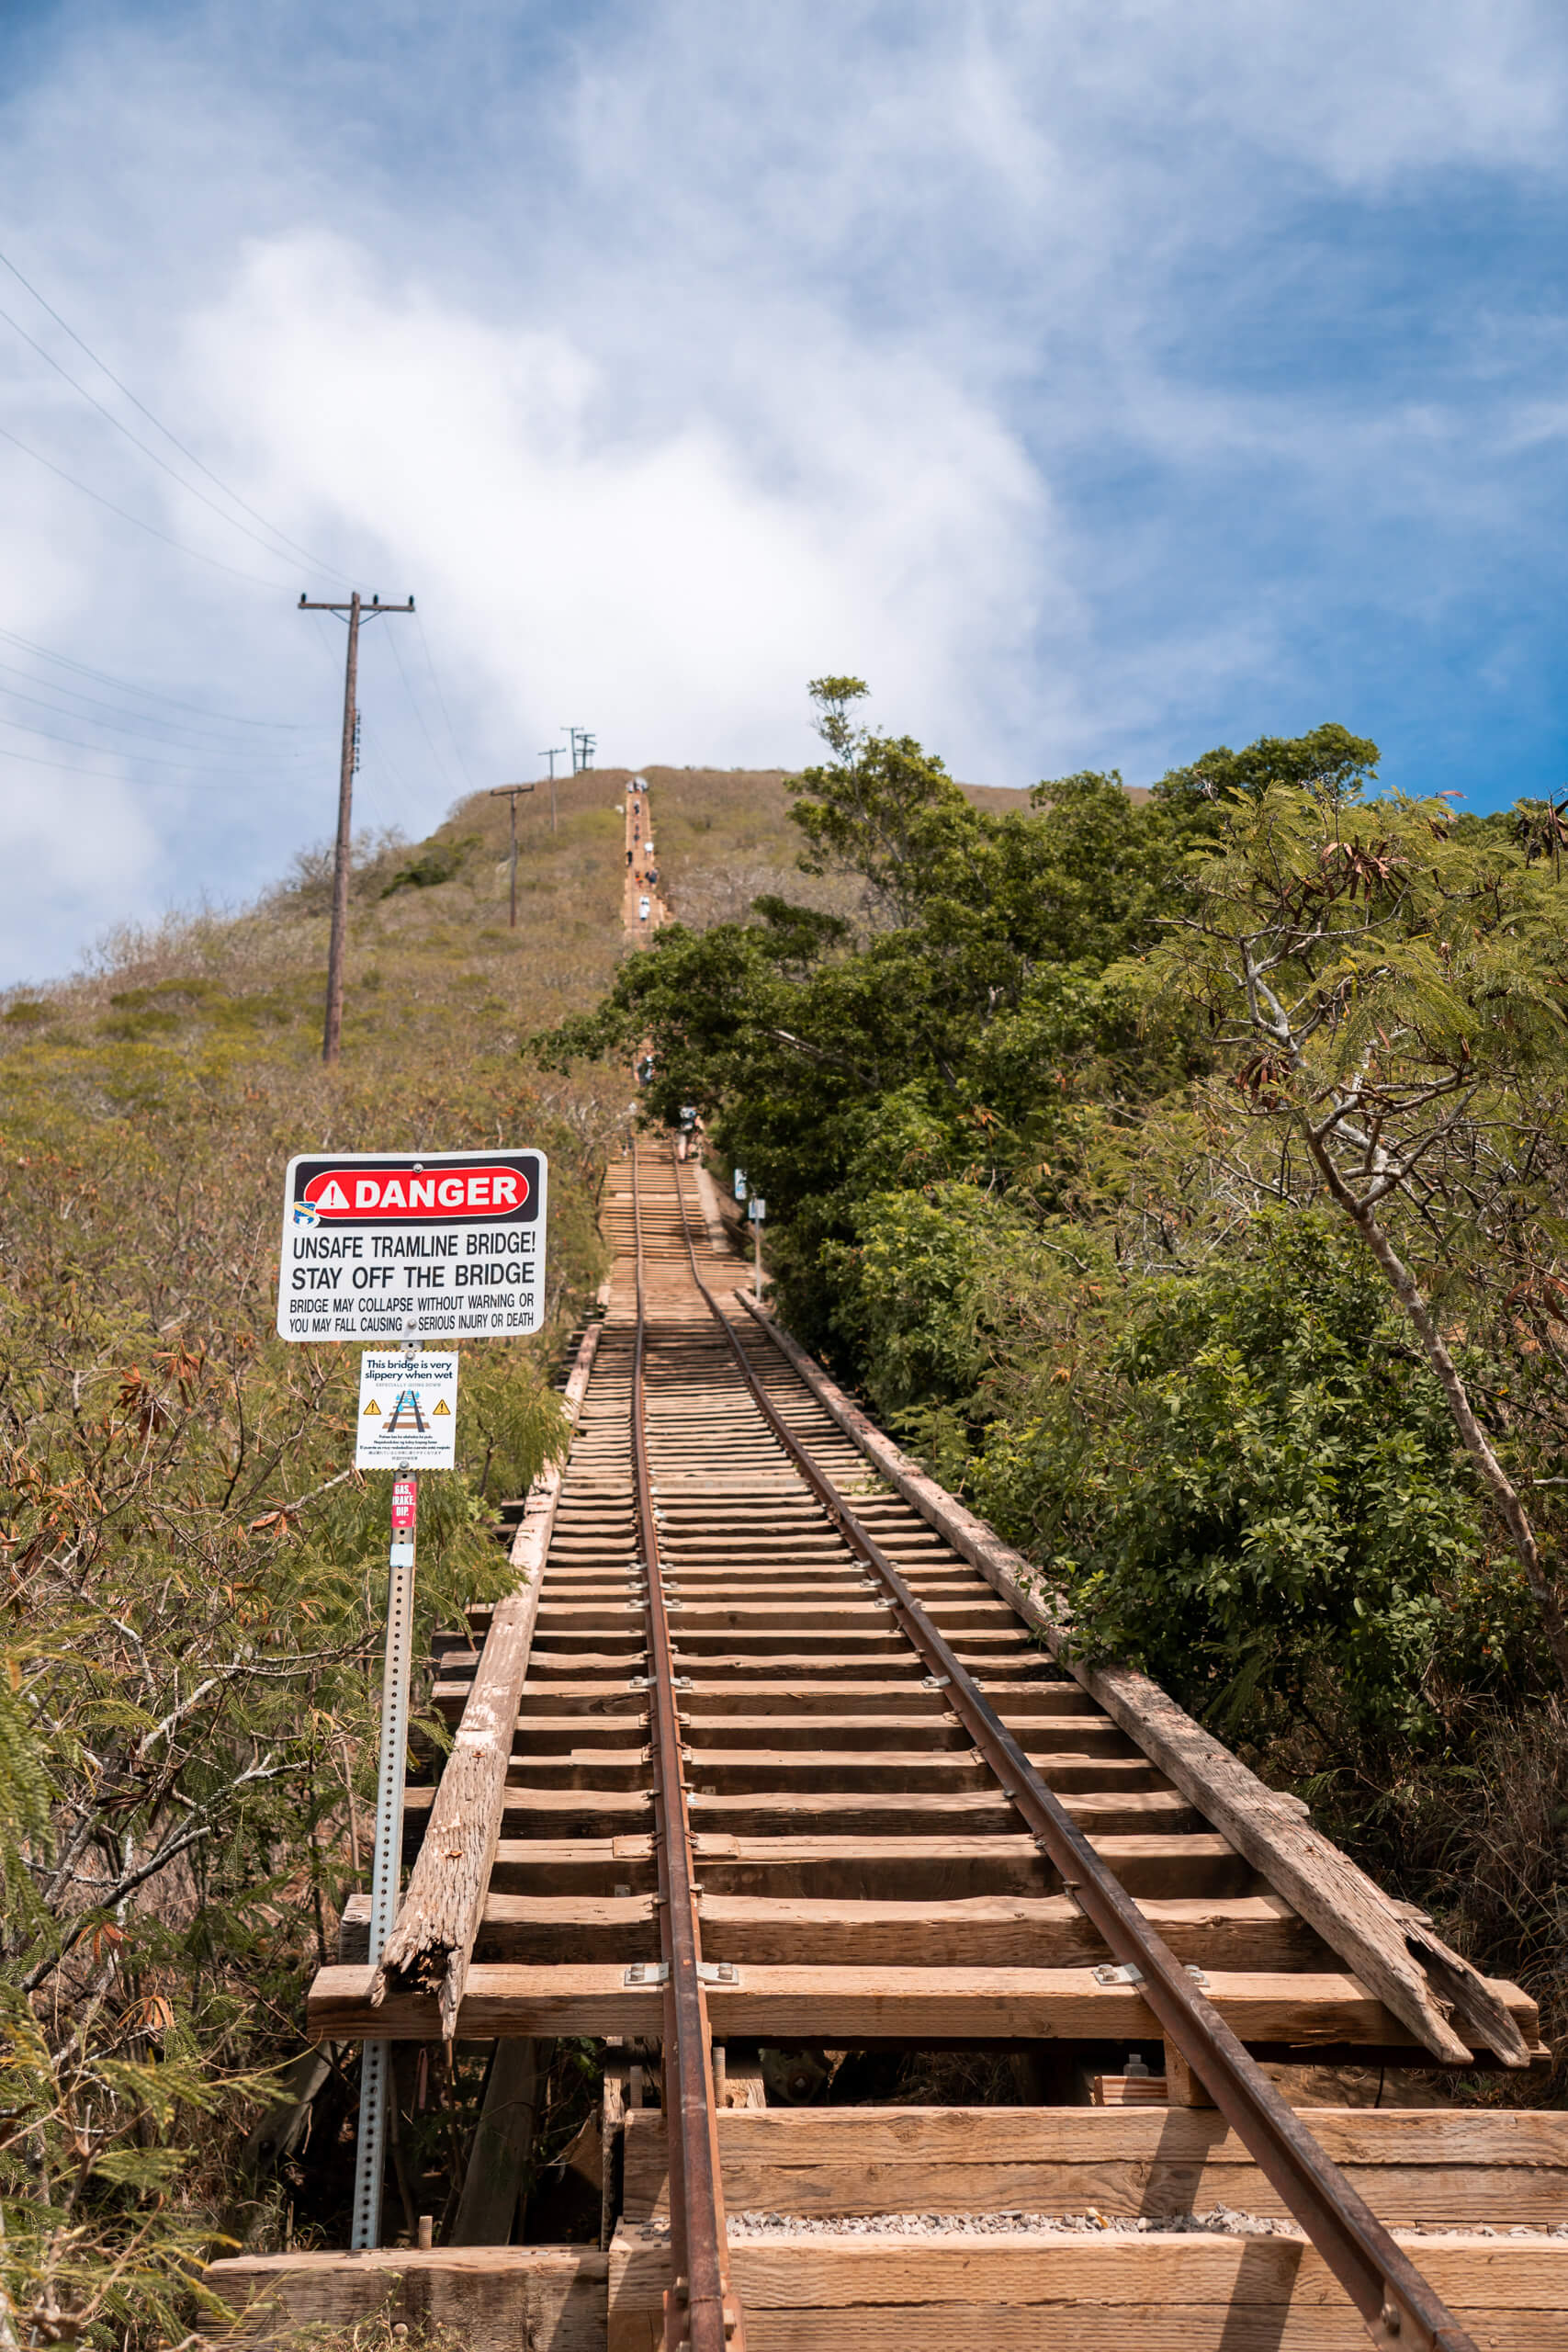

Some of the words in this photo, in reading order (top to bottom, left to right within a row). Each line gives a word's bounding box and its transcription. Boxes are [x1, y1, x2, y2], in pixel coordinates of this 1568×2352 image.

[355, 1177, 517, 1208] DANGER
[293, 1237, 364, 1260] UNSAFE
[371, 1235, 458, 1258] TRAMLINE
[466, 1231, 536, 1255] BRIDGE!
[291, 1267, 343, 1290] STAY
[352, 1267, 395, 1289] OFF
[403, 1266, 445, 1288] THE
[455, 1261, 535, 1286] BRIDGE
[289, 1299, 329, 1313] BRIDGE
[333, 1298, 355, 1312] MAY
[358, 1297, 413, 1312] COLLAPSE
[417, 1295, 464, 1311] WITHOUT
[468, 1294, 514, 1309] WARNING
[519, 1293, 534, 1307] OR
[289, 1318, 309, 1332] YOU
[312, 1317, 332, 1332] MAY
[334, 1317, 356, 1331] FALL
[360, 1317, 402, 1331] CAUSING
[418, 1315, 456, 1330] SERIOUS
[458, 1314, 488, 1329] INJURY
[491, 1314, 503, 1328] OR
[506, 1312, 534, 1327] DEATH
[365, 1370, 403, 1381] slippery
[405, 1370, 432, 1379] when
[434, 1371, 453, 1379] wet
[367, 1360, 386, 1369] This
[388, 1360, 419, 1371] bridge
[421, 1360, 428, 1369] is
[430, 1363, 452, 1371] very
[395, 1485, 412, 1494] GAS.
[396, 1507, 410, 1516] DIP.
